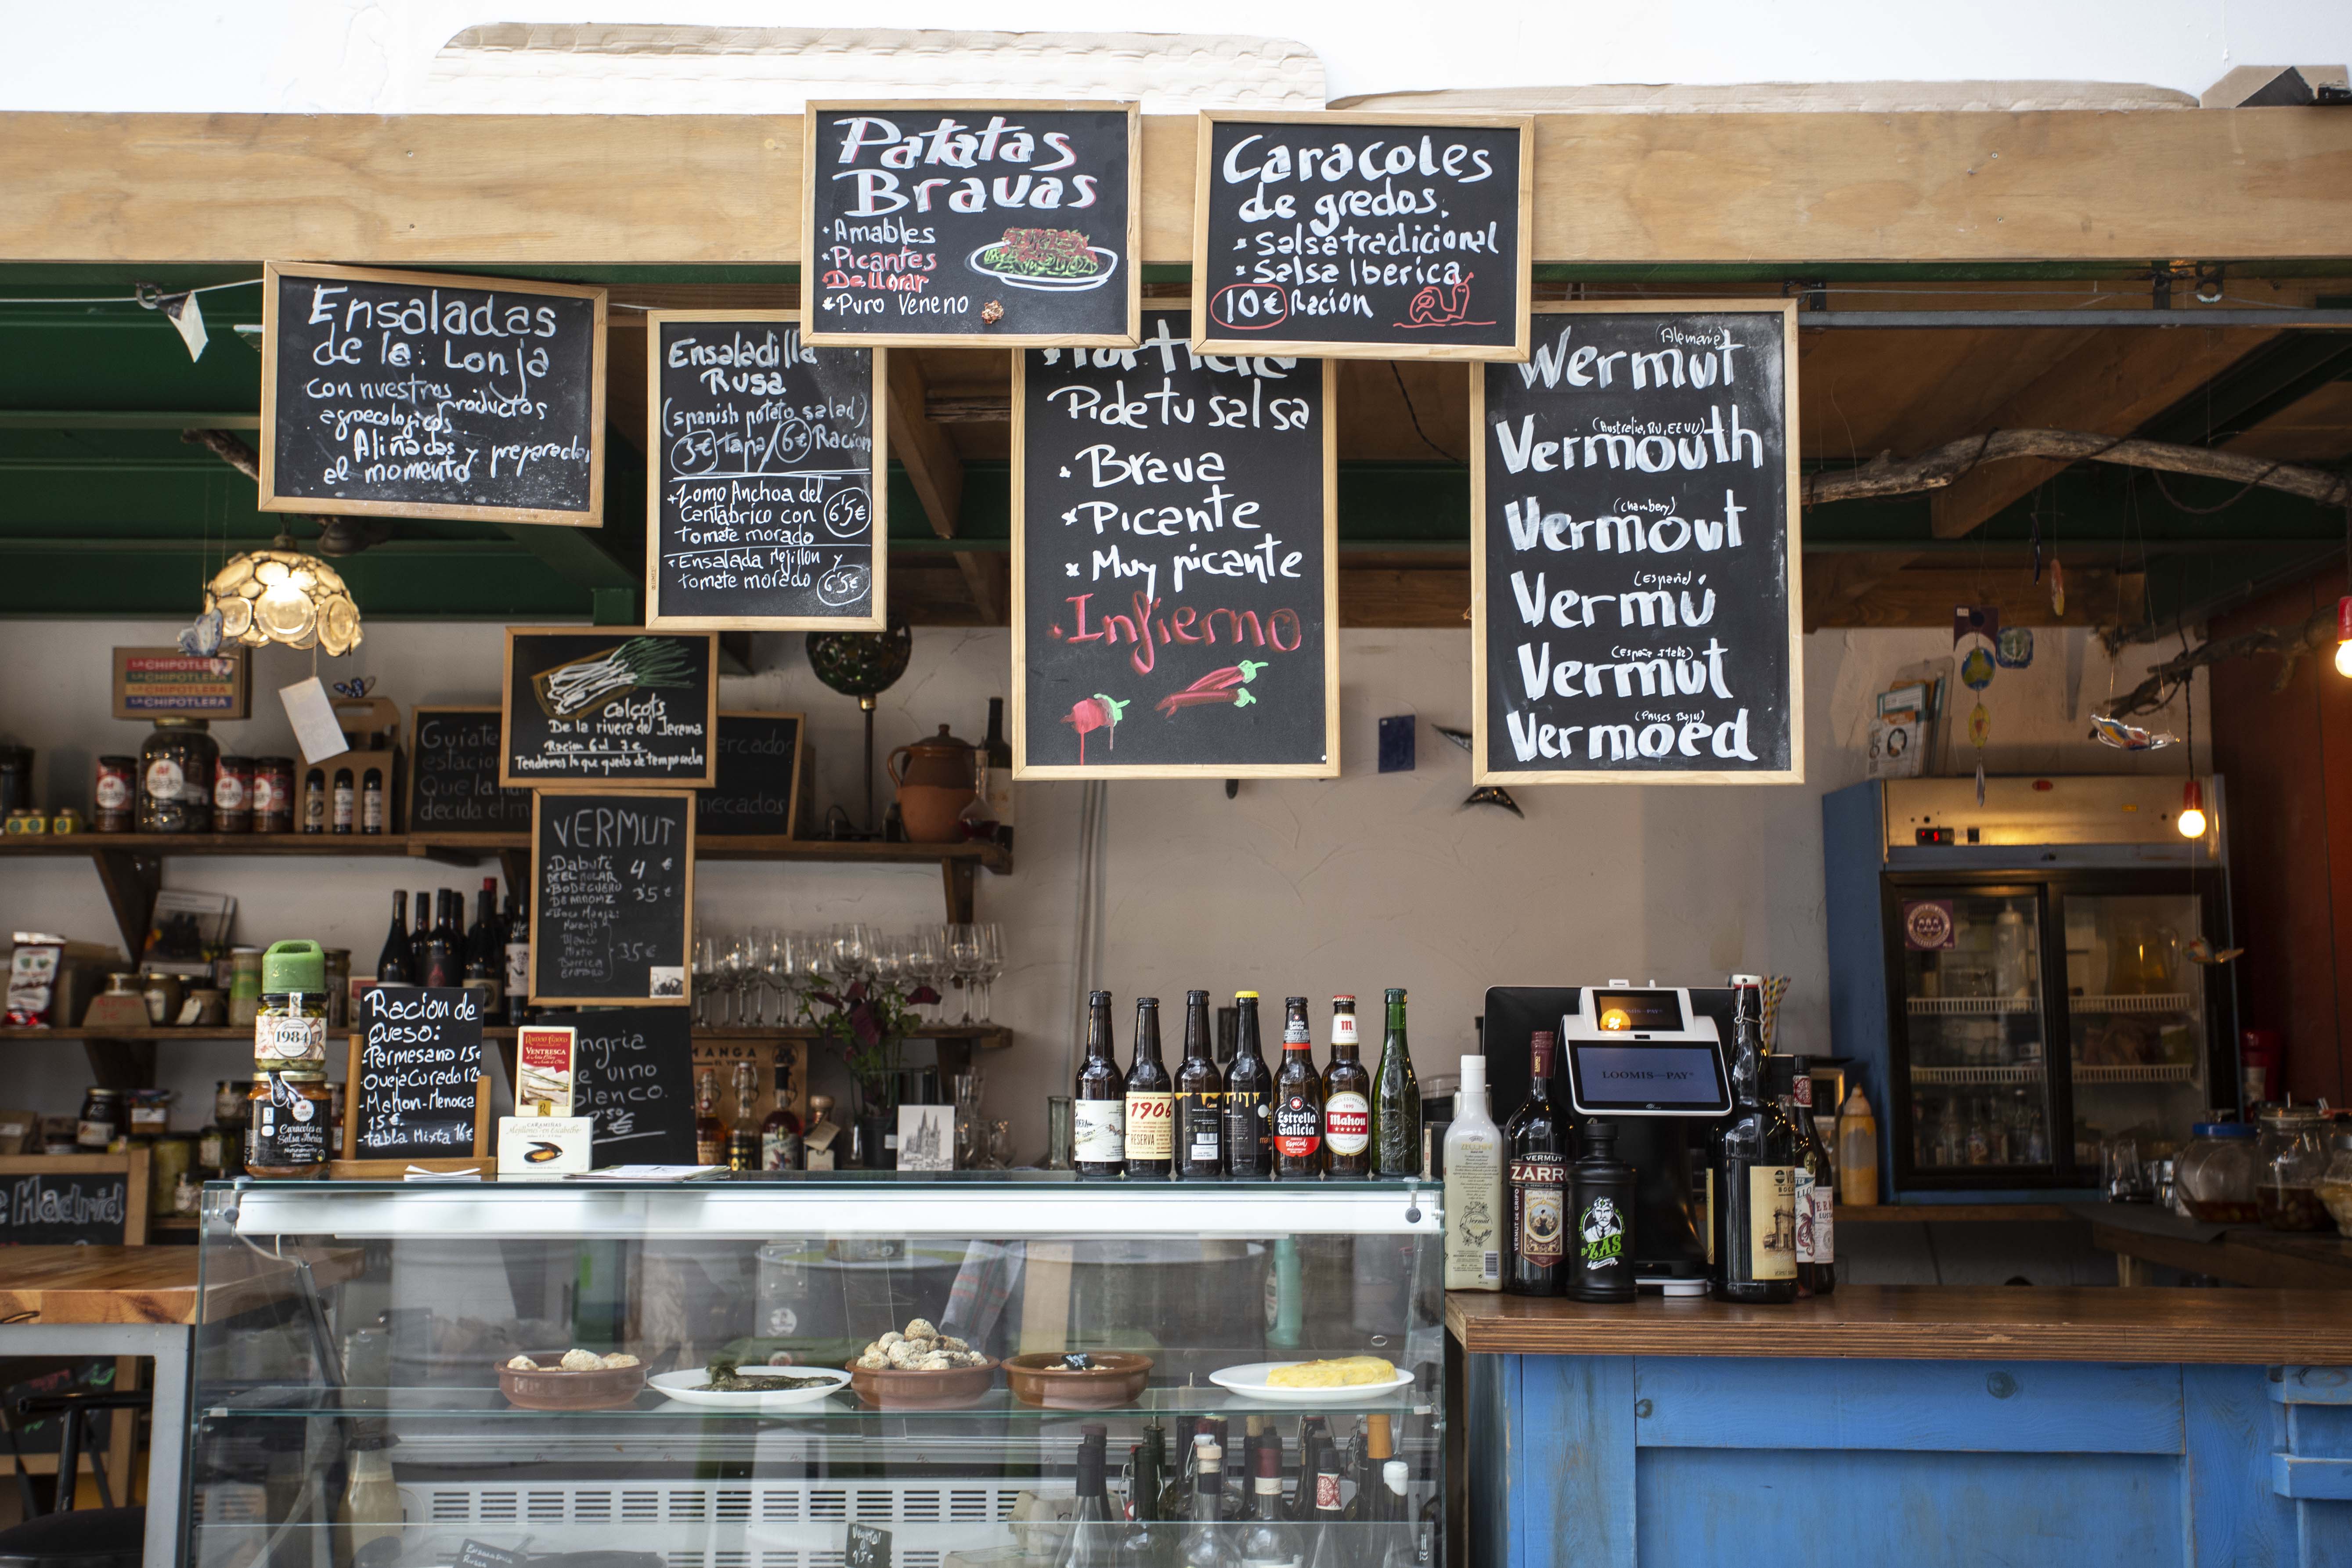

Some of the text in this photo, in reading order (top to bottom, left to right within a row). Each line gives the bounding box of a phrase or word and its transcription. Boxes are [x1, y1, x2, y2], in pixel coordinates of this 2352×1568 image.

[833, 116, 1078, 171] Patatas
[1223, 134, 1493, 184] Caracoles
[832, 169, 1097, 217] Bravas
[1238, 182, 1296, 222] de
[835, 217, 936, 244] Amables
[830, 246, 937, 273] Picantes
[1253, 256, 1461, 286] Salsa Iberica
[308, 285, 556, 339] Ensaladas
[836, 293, 969, 316] Puro Veneno
[1291, 288, 1374, 318] Racion
[312, 322, 362, 365] de
[445, 339, 549, 403] Lonja
[669, 329, 818, 369] Ensaladilla
[1518, 325, 1745, 389] Wermut
[307, 373, 452, 404] con nuestros
[700, 368, 786, 395] Rusa
[437, 390, 547, 423] productos
[1047, 377, 1309, 430] Pide tu salsa
[746, 399, 794, 438] potato
[812, 423, 872, 452] Racion
[1496, 404, 1763, 473] Vermouth
[365, 456, 470, 484] momento
[1075, 444, 1226, 487] Brava
[732, 480, 794, 505] Anchoa
[799, 475, 823, 503] del
[681, 502, 772, 526] Cantabrico
[781, 510, 816, 524] con
[1078, 484, 1261, 536] Picante
[1505, 489, 1747, 553] Vermout
[674, 524, 814, 545] tomate morado
[678, 573, 738, 590] tomate
[745, 565, 811, 589] morado
[679, 548, 763, 570] Ensalada
[771, 547, 820, 580] Mejillon
[1093, 533, 1302, 604] Muy picante
[1511, 570, 1716, 628] Vermú
[1066, 591, 1302, 676] Infierno
[145, 659, 210, 670] CHIPOTLE
[1518, 638, 1733, 701] Vermut
[144, 698, 226, 707] CHIPOTLERA
[422, 720, 499, 749] Guiate
[548, 720, 572, 733] De
[577, 719, 589, 733] la
[1506, 708, 1758, 762] Vermoed
[422, 748, 501, 770] estacio
[581, 759, 598, 773] que
[420, 775, 470, 797] Que
[474, 773, 493, 796] la
[420, 797, 482, 821] decida
[488, 796, 505, 819] el
[553, 808, 675, 847] VERMUT
[630, 859, 646, 880] 4
[364, 989, 478, 1021] Racion de
[276, 1031, 308, 1042] 1984
[576, 1030, 646, 1070] ngria
[575, 1064, 657, 1085] e vino
[1132, 1099, 1172, 1120] 1906
[1277, 1111, 1316, 1124] Estrella
[1330, 1114, 1366, 1126] Mahou
[277, 1133, 300, 1145] Salsa
[280, 1123, 314, 1135] Caracoles
[363, 1128, 408, 1147] tabla
[414, 1127, 451, 1144] Mixta
[1131, 1134, 1154, 1146] RESERVA
[1278, 1123, 1314, 1135] Galicia
[1511, 1166, 1567, 1181] ZARR
[12, 1174, 125, 1227] Madrid
[1515, 1212, 1519, 1221] DE
[1588, 1235, 1621, 1259] ZAS
